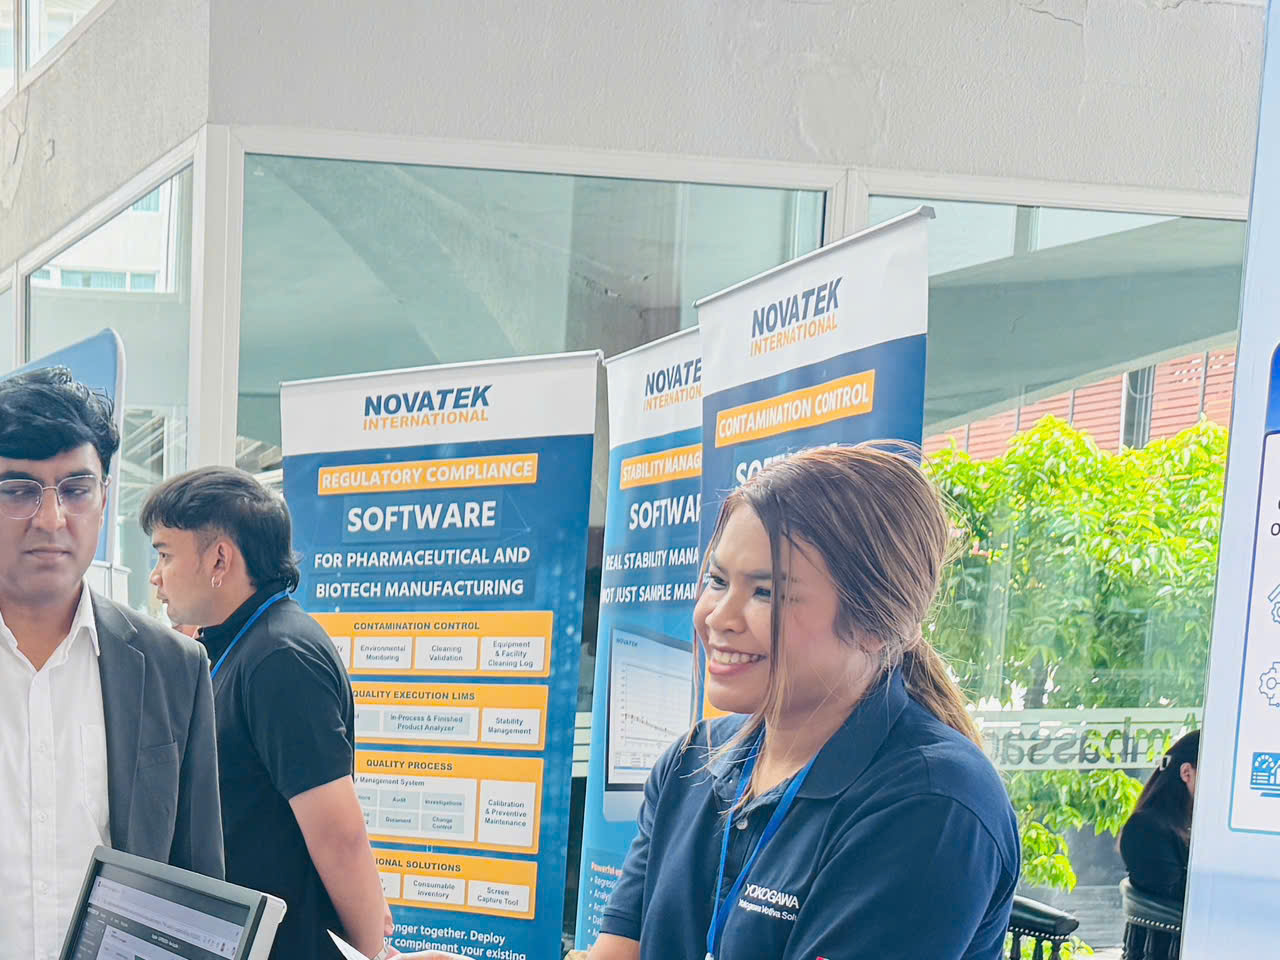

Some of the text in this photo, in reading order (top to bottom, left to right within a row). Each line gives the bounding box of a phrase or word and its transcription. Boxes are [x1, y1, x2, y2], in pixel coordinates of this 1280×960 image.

[751, 276, 843, 338] NOVATEK
[750, 313, 838, 357] INTERNATIONAL
[645, 357, 702, 397] NOVATE
[364, 384, 493, 416] NOVATEK
[643, 384, 703, 412] INTERNATION
[719, 383, 870, 438] CONTAMINATION CONTROL
[363, 410, 488, 430] INTERNATIONAL
[623, 452, 701, 481] STABILITY MANAG
[322, 460, 533, 489] REGULATORY COMPLIANCE
[347, 500, 496, 532] SOFTWARE
[314, 547, 530, 568] FOR PHARMACEUTICAL AND
[606, 548, 699, 570] REAL STABILITY MANA
[315, 579, 524, 598] BIOTECH MANUFACTURING
[615, 586, 637, 602] JUST
[639, 584, 671, 602] SAMPLE
[353, 621, 480, 631] CONTAMINATION CONTROL
[360, 644, 406, 652] Environmental
[431, 645, 462, 654] Cleaning
[492, 640, 531, 650] Equipment
[429, 654, 463, 662] Validation
[501, 650, 527, 659] Facility
[488, 659, 534, 669] Cleaning Log
[352, 690, 475, 700] QUALITY EXECUTION LIMS
[390, 714, 425, 723] In-Process
[433, 715, 463, 723] Finished
[495, 717, 523, 726] Stability
[397, 723, 455, 733] Product Analyzer
[488, 727, 531, 736] Management
[366, 759, 453, 771] QUALITY PROCESS
[360, 777, 399, 787] Management
[401, 779, 425, 787] System
[488, 799, 524, 808] Calibration
[491, 809, 527, 818] Preventive
[484, 817, 527, 827] Maintenance
[376, 858, 461, 872] IONAL SOLUTIONS
[413, 880, 455, 890] Consumable
[417, 890, 449, 899] Inventory
[487, 887, 510, 896] Screen
[744, 883, 799, 909] YOKOGAWA
[477, 895, 519, 906] Capture Tool
[392, 923, 505, 946] onger together. Deploy
[395, 938, 458, 953] complement
[461, 945, 484, 957] your
